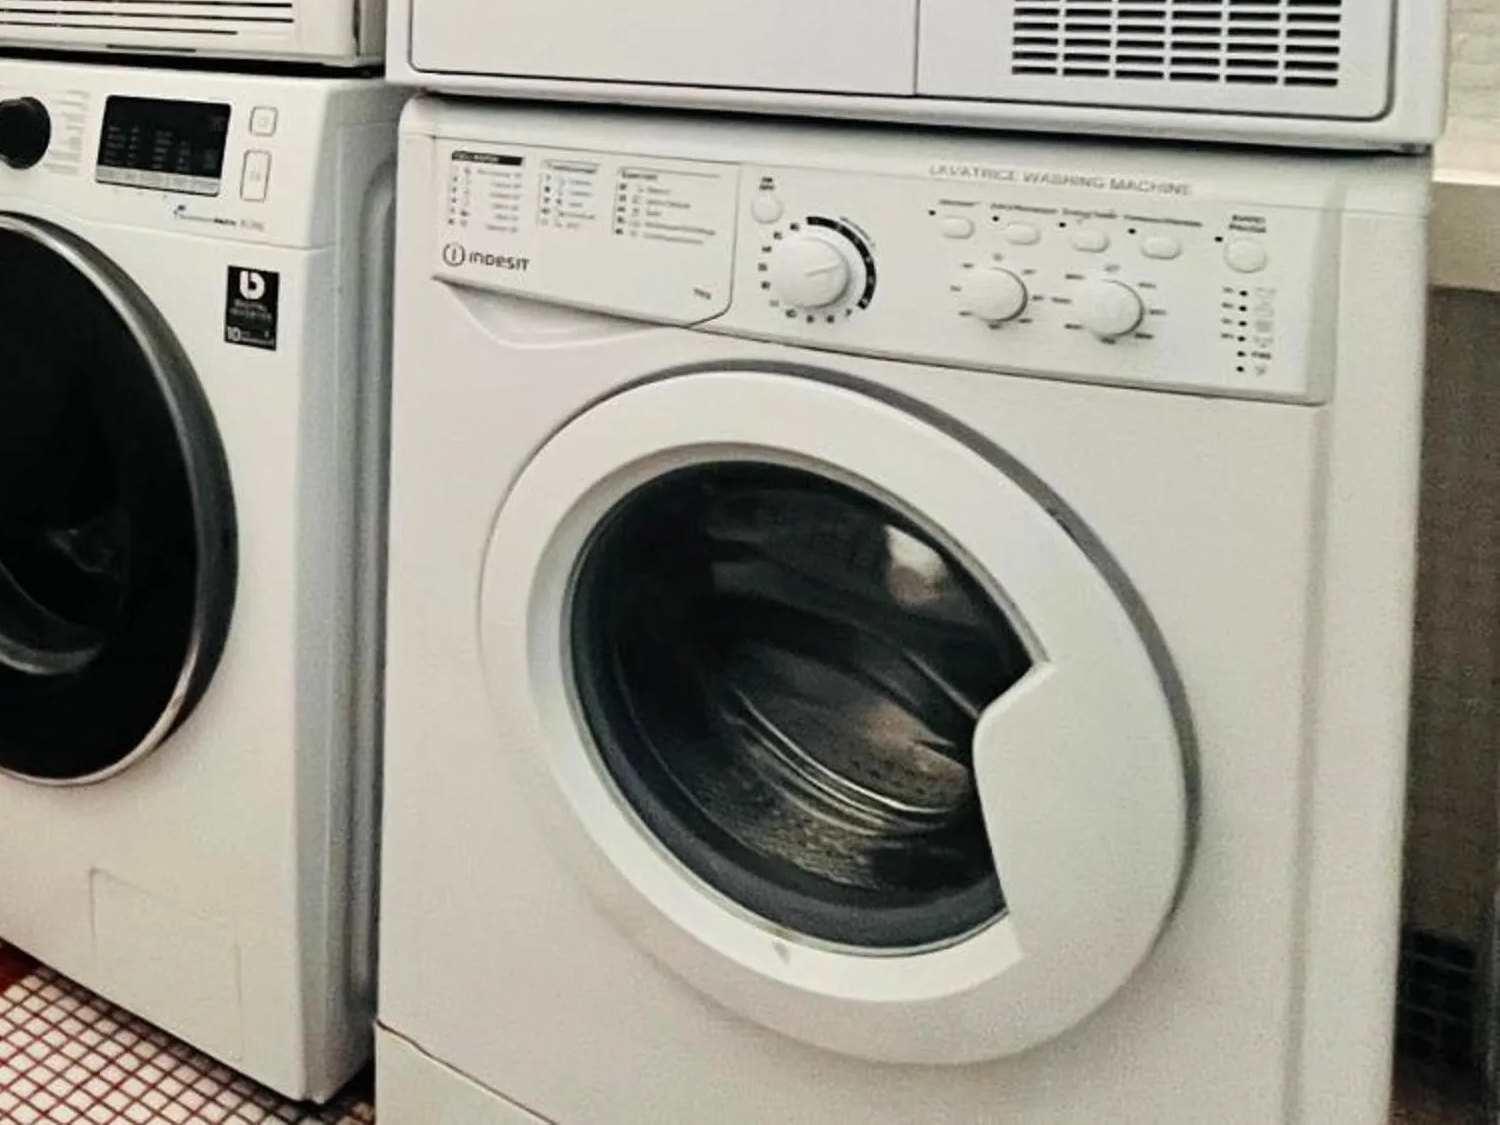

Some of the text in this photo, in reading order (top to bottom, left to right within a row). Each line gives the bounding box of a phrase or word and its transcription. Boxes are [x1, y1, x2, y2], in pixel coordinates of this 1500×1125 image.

[928, 163, 1192, 196] LAVATRICE WASHING MACHINE
